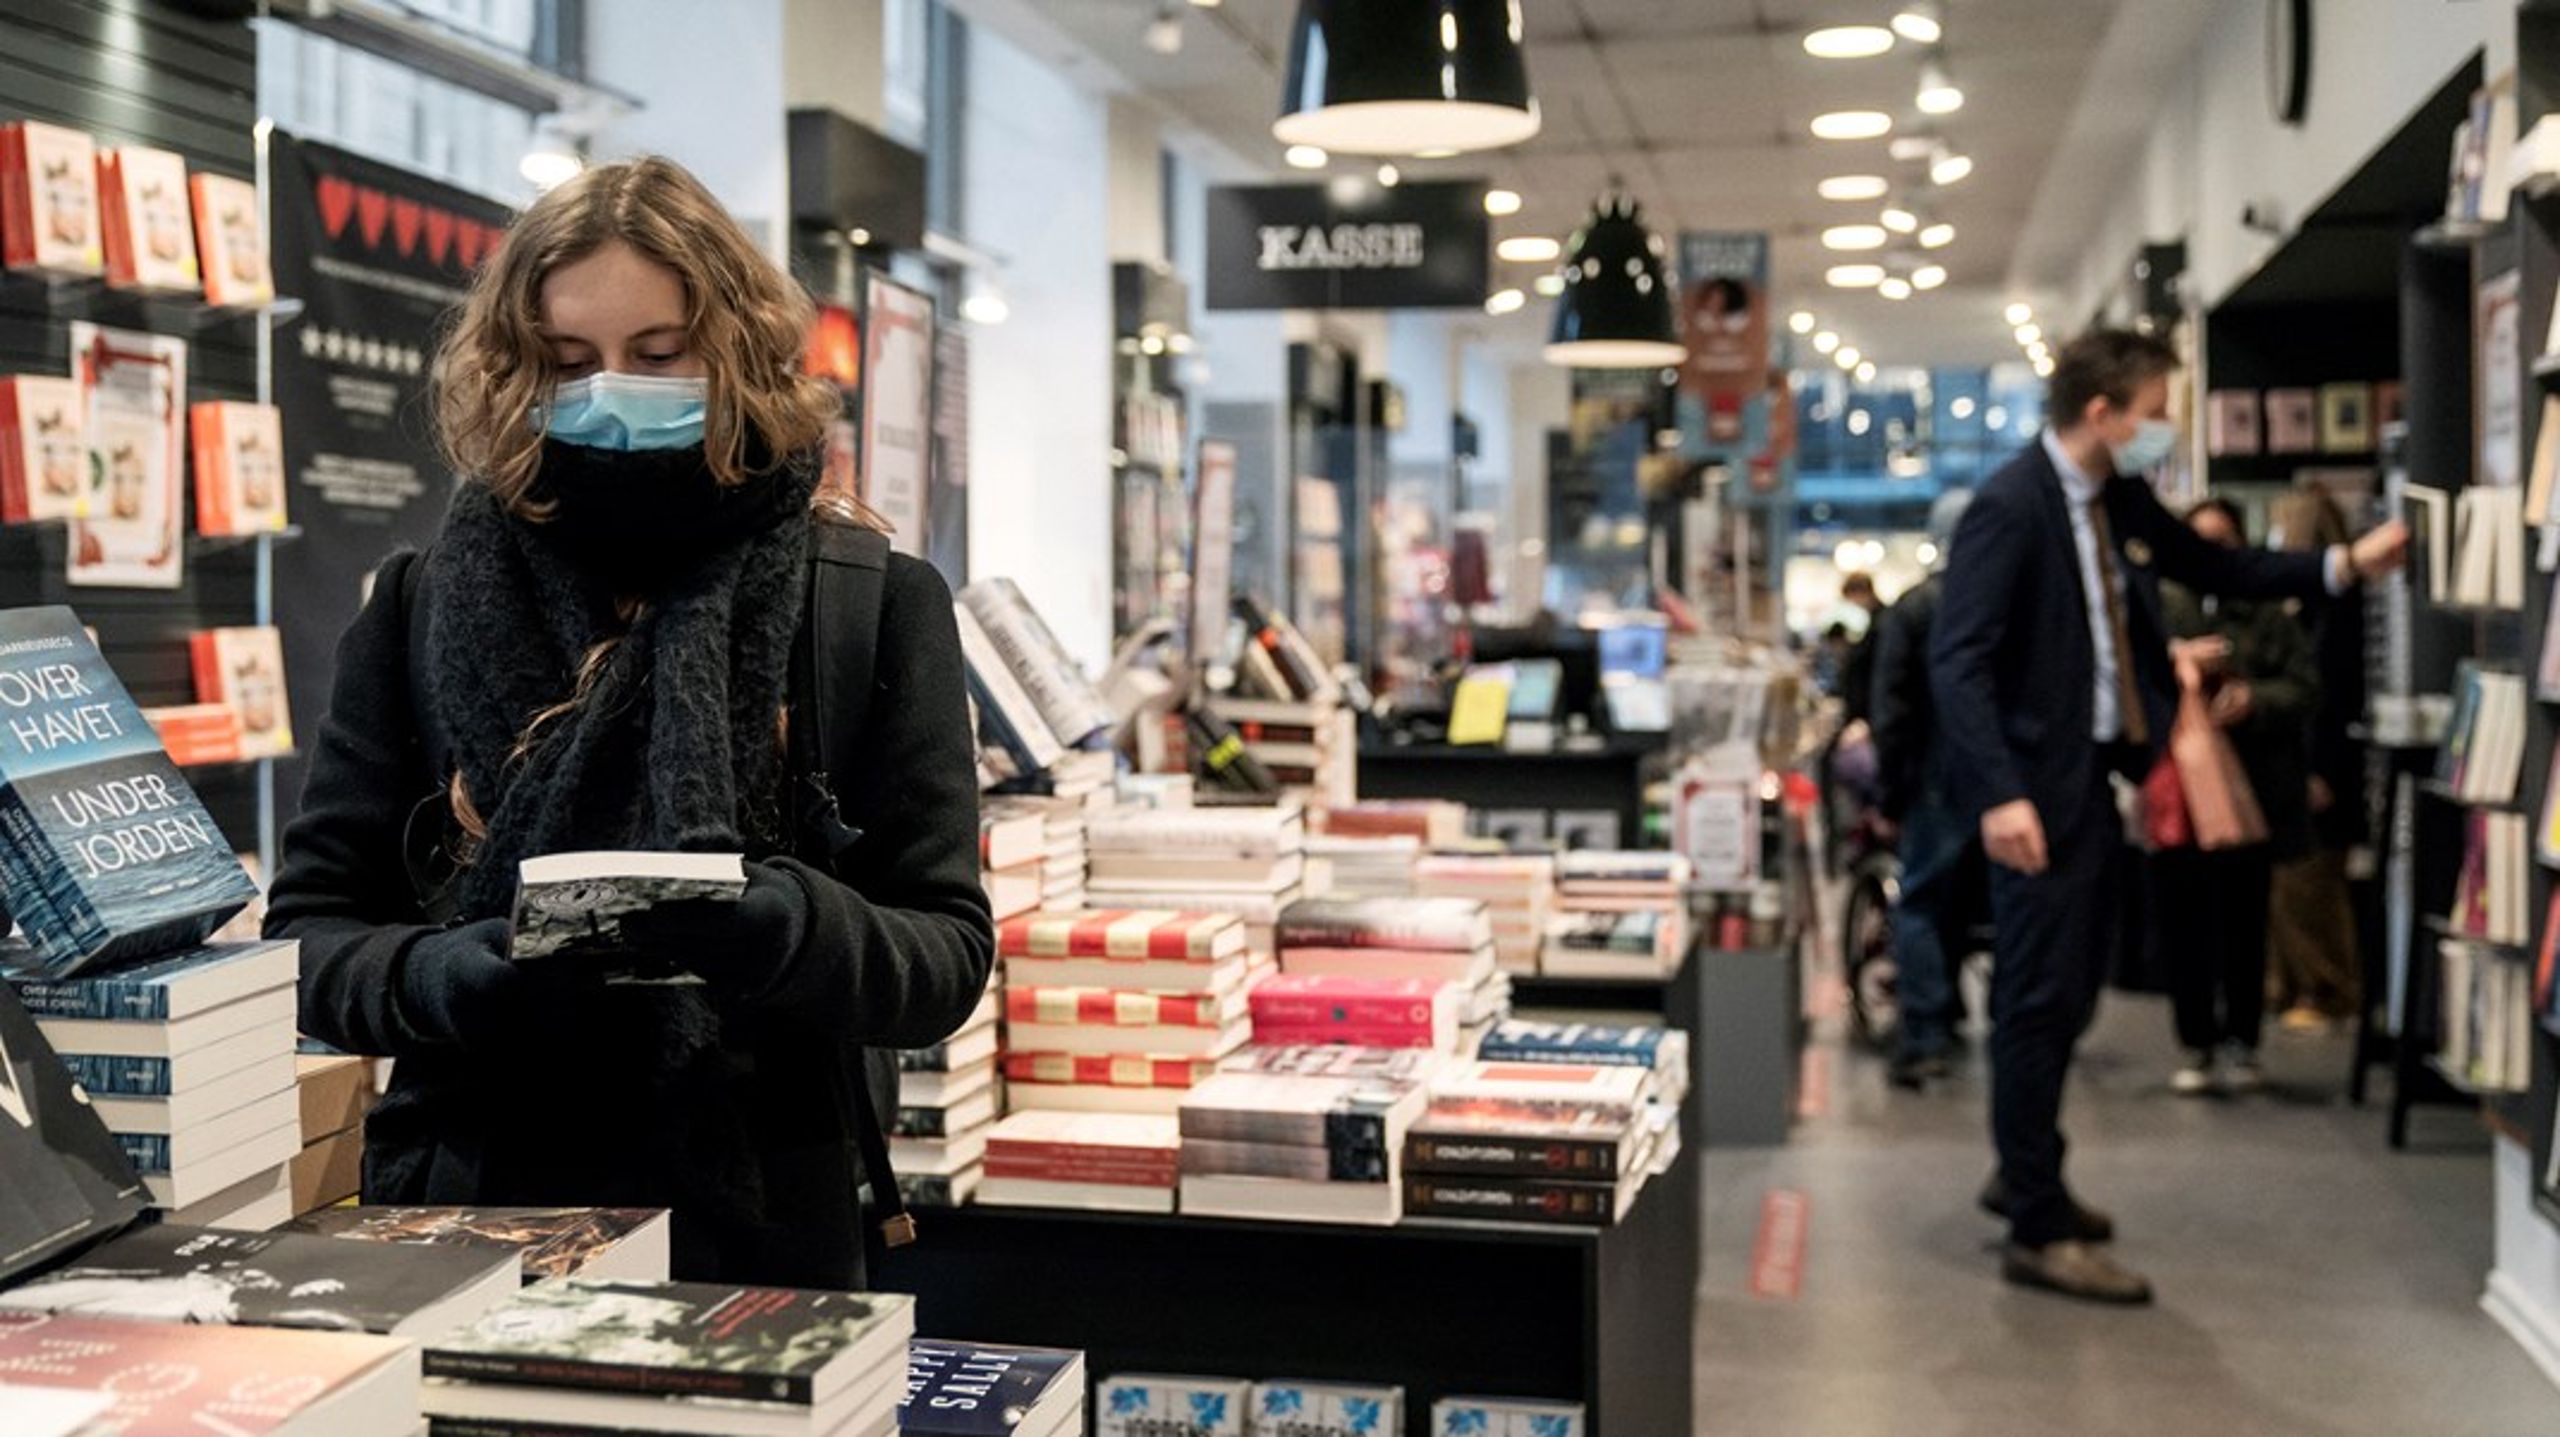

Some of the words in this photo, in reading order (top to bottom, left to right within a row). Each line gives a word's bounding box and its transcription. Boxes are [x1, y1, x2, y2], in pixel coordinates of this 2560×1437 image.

[1258, 224, 1424, 270] KASSE
[0, 663, 93, 707] OVER
[9, 702, 123, 754] HAVET
[51, 773, 178, 828] UNDER
[74, 813, 212, 879] JORDEN
[929, 1351, 1019, 1411] SALLY
